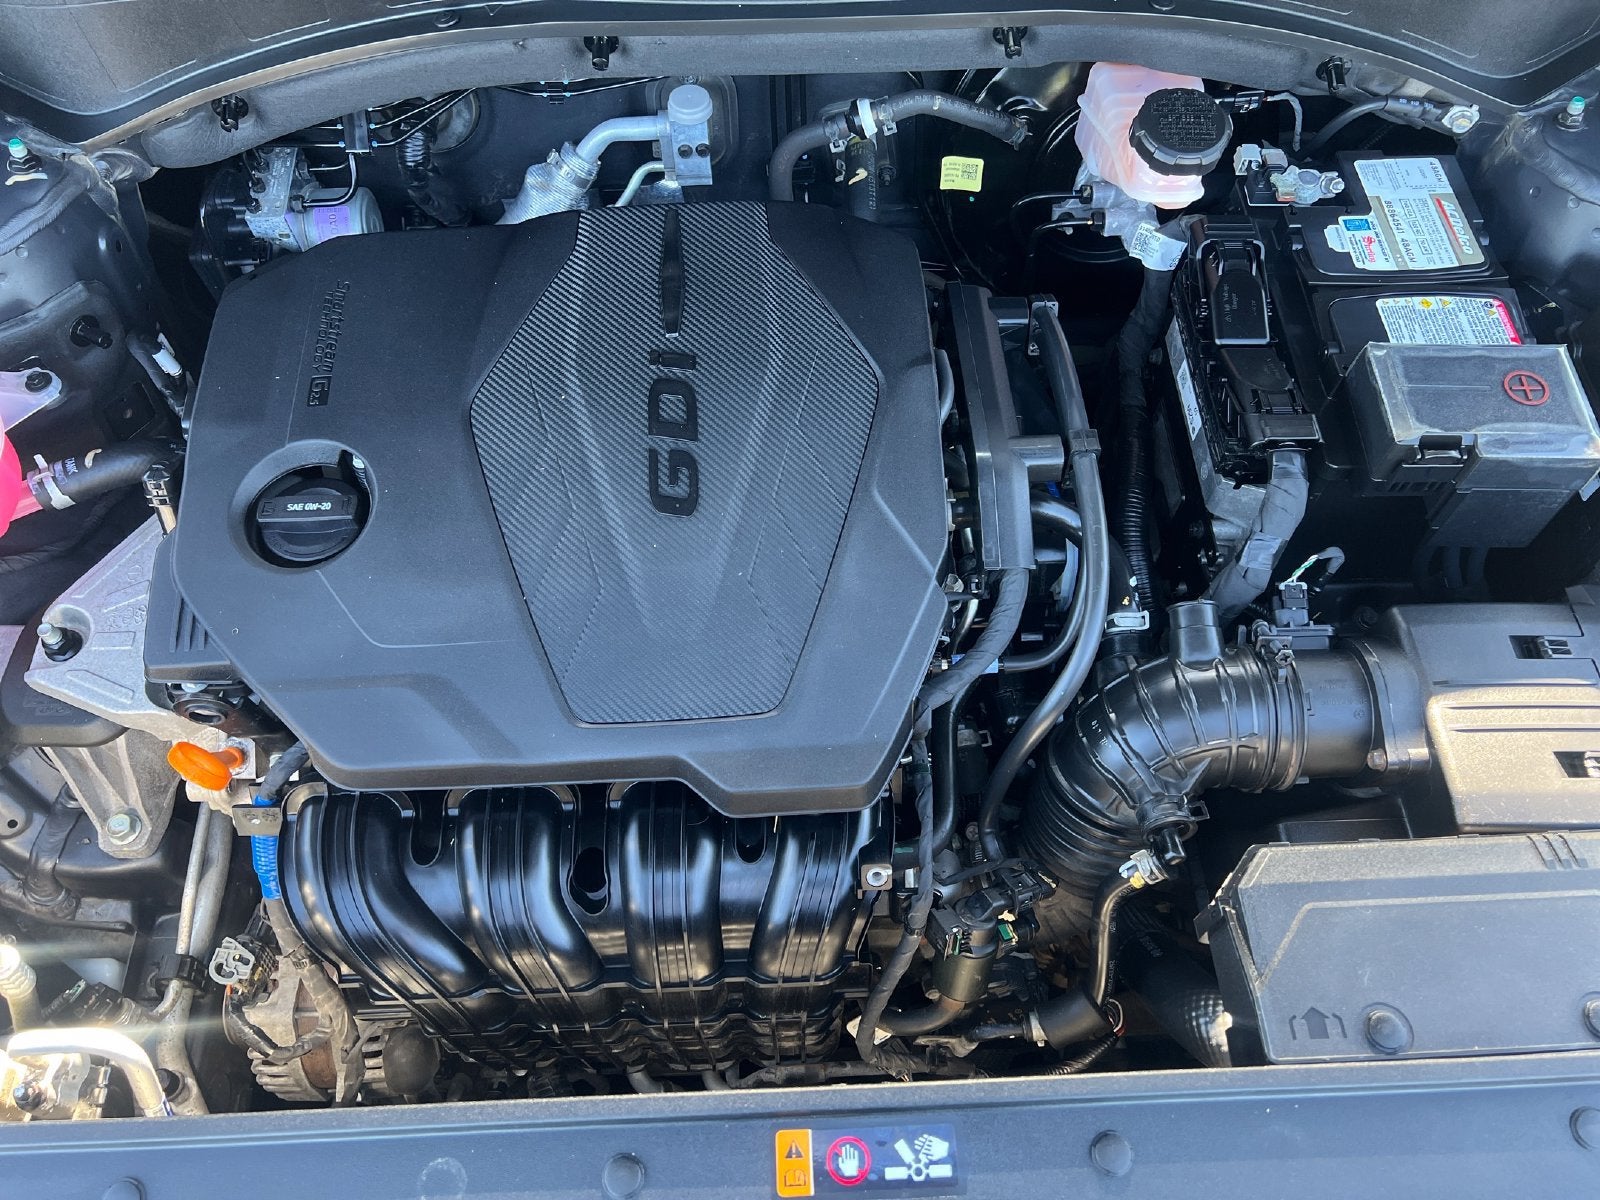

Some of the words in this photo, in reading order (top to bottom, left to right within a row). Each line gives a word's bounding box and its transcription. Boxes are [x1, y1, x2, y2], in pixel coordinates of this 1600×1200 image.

[1429, 161, 1444, 183] 48AGM
[1384, 200, 1406, 234] 88864541
[1400, 238, 1417, 263] 48AGM
[1441, 199, 1474, 255] ACDelco
[312, 291, 334, 373] TECHNOLOGY
[323, 279, 351, 373] Smartstream
[308, 378, 330, 406] G2.5
[286, 503, 304, 511] SAE
[304, 502, 332, 511] 0W-20
